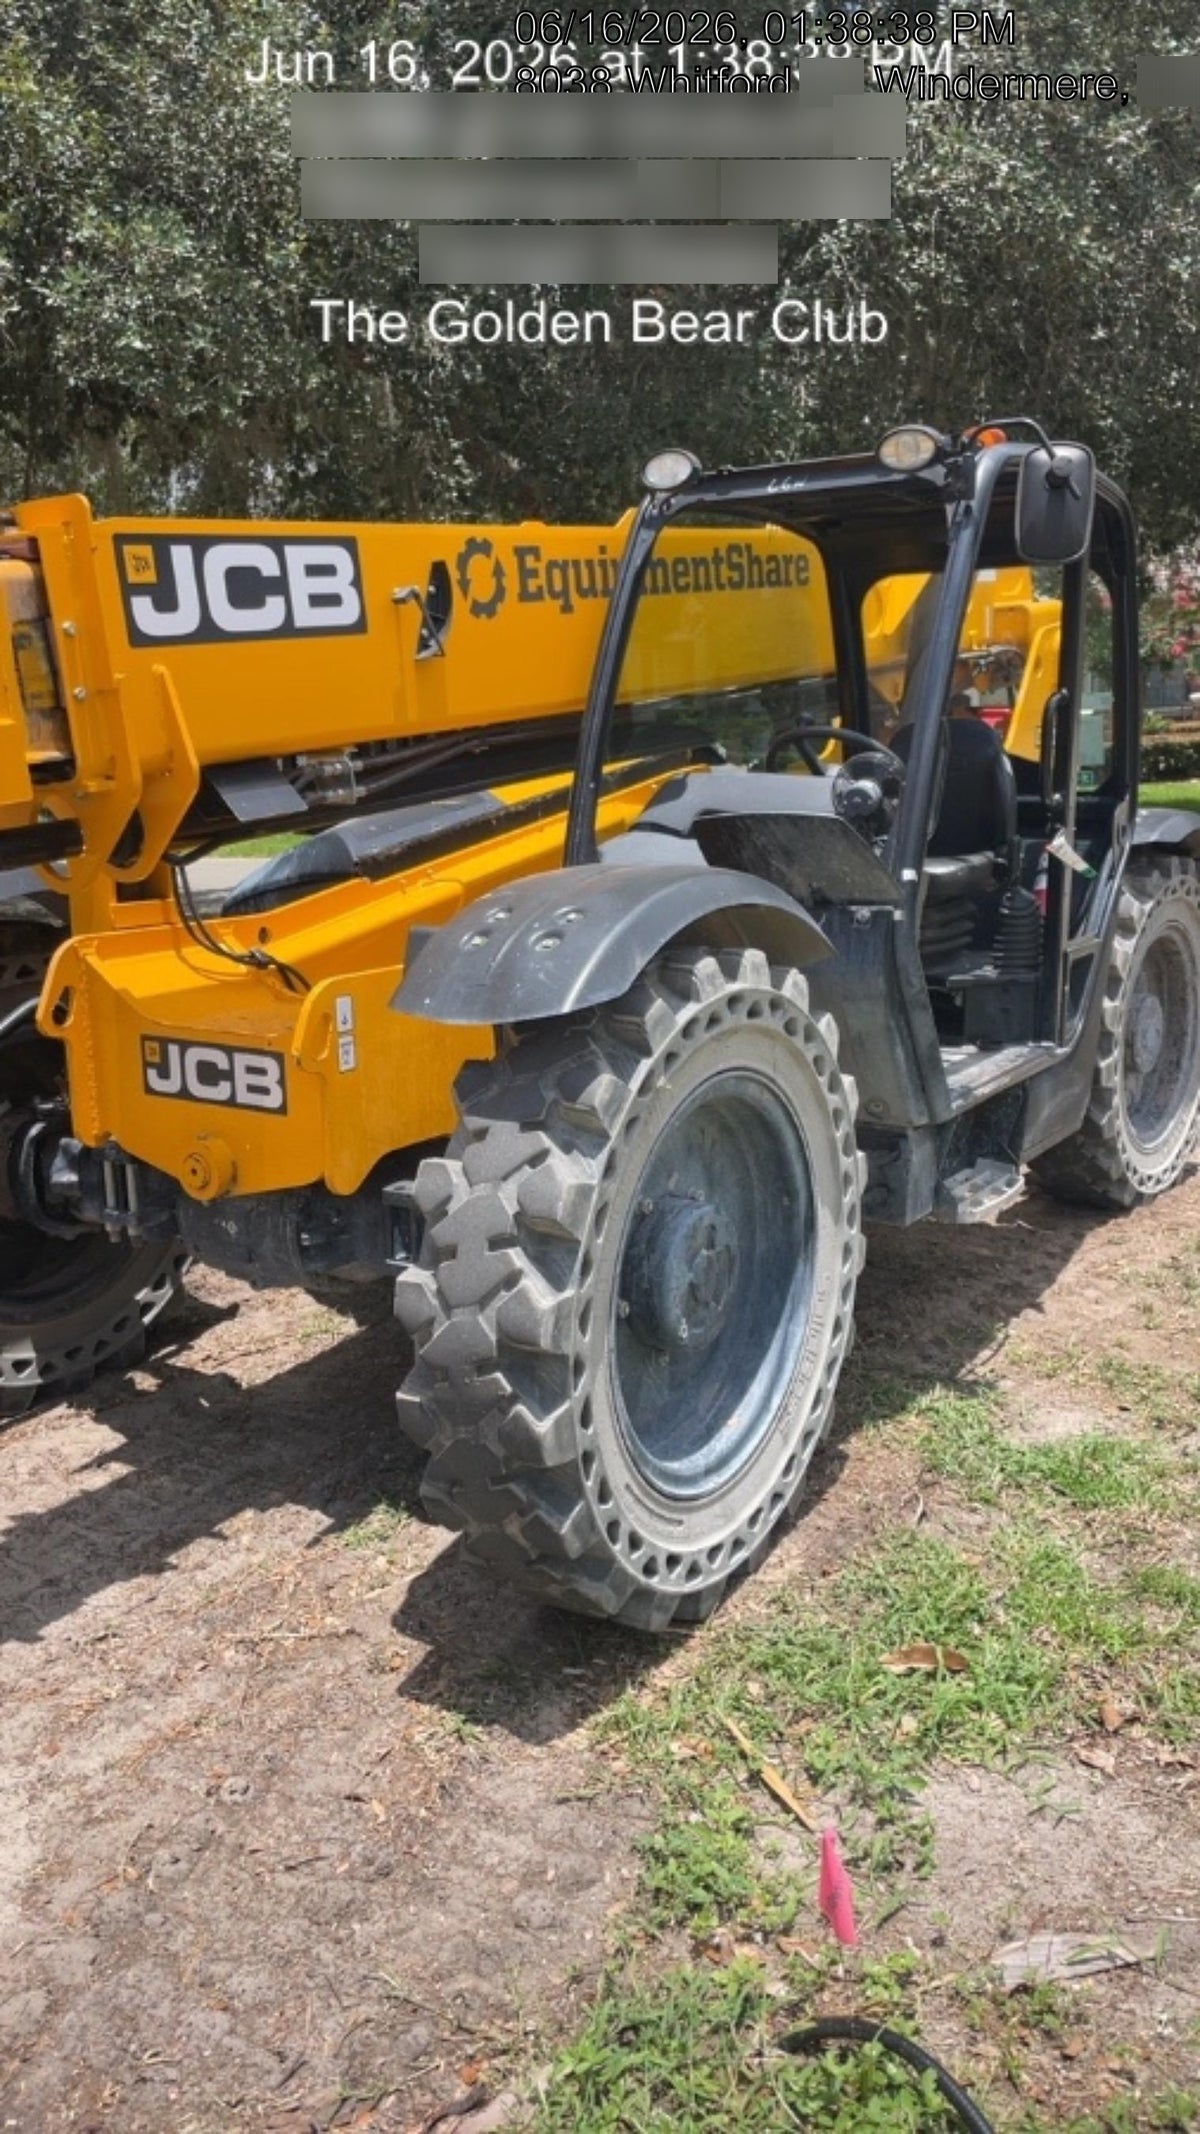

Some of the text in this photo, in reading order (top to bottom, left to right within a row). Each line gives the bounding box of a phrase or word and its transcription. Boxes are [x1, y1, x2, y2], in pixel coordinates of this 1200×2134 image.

[130, 542, 362, 637] JCB
[513, 543, 811, 615] EquimentShare
[146, 1043, 284, 1109] JCB
